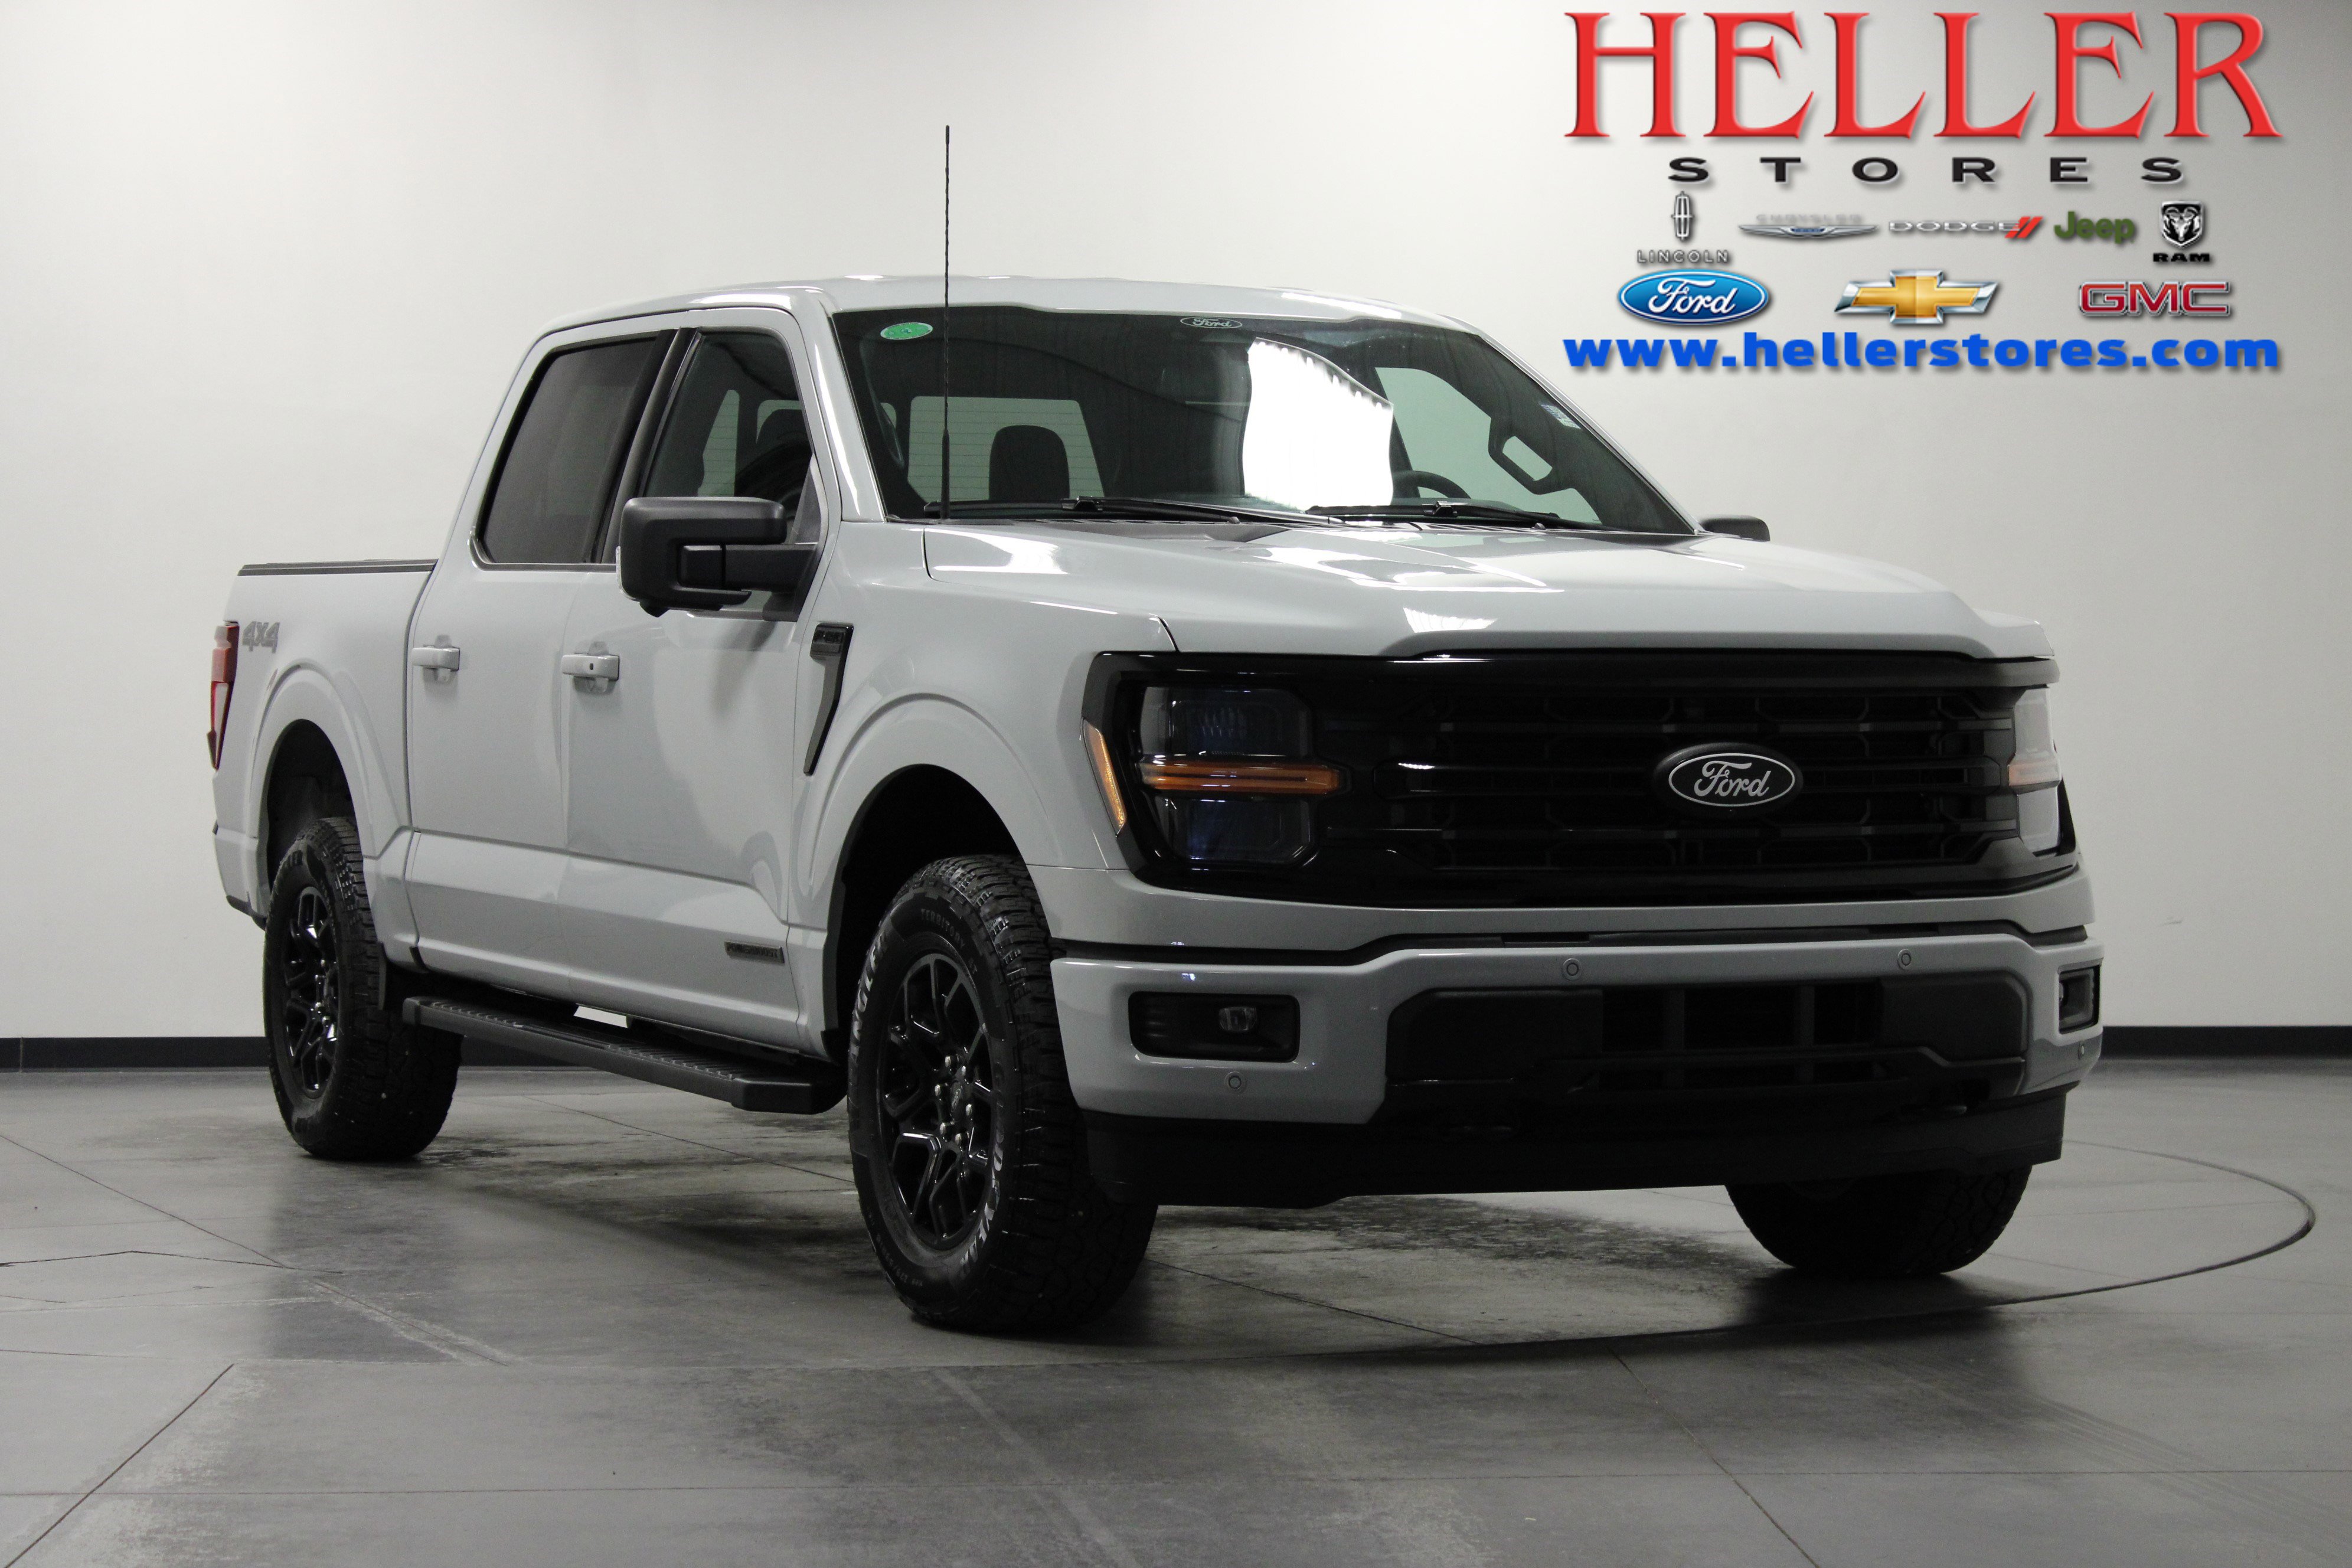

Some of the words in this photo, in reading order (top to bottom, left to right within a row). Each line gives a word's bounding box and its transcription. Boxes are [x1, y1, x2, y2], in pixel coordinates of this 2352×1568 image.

[1193, 318, 1231, 326] Ford
[1693, 760, 1772, 797] Ford
[920, 908, 965, 949] TERRITORY
[848, 931, 887, 1105] ANGLER
